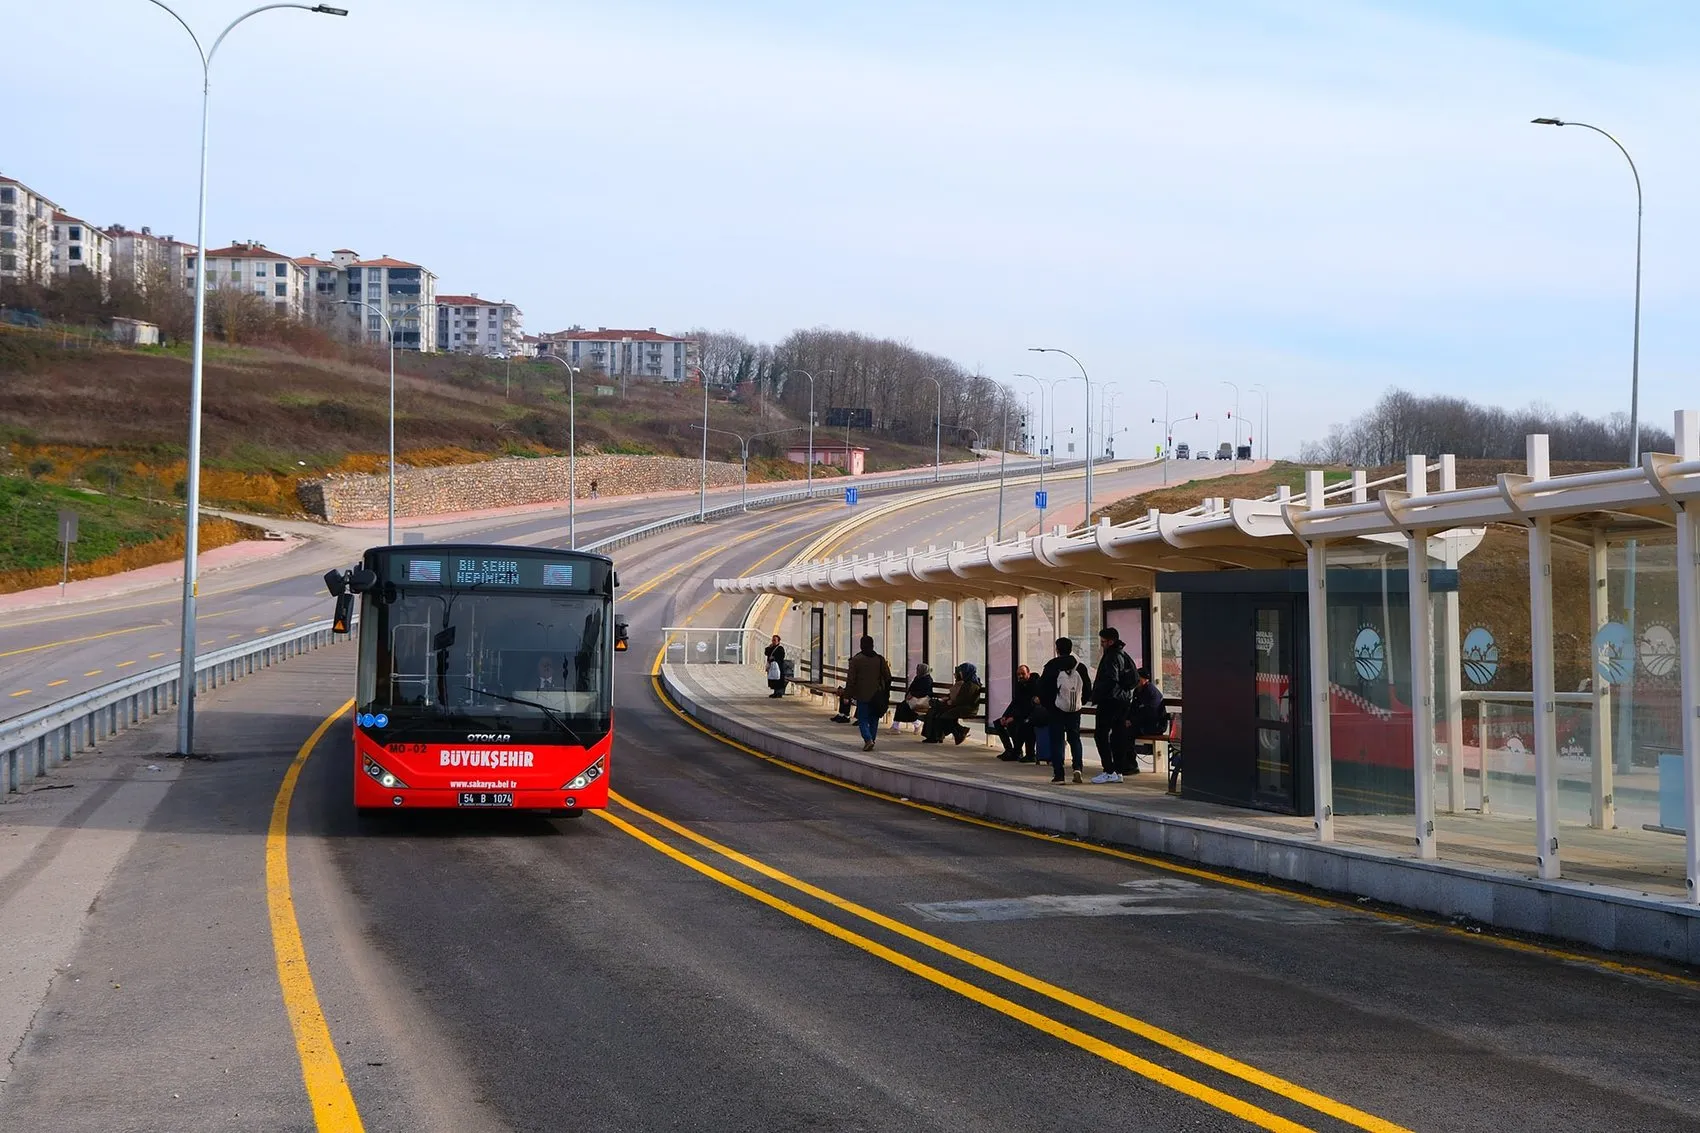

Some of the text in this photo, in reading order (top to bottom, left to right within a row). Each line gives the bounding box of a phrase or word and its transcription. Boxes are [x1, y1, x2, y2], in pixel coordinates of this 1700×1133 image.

[459, 560, 475, 571] BU
[467, 733, 511, 743] OTOKAR
[440, 750, 534, 769] BÜYÜKŞEHİR
[463, 793, 512, 803] 54 B 1074
